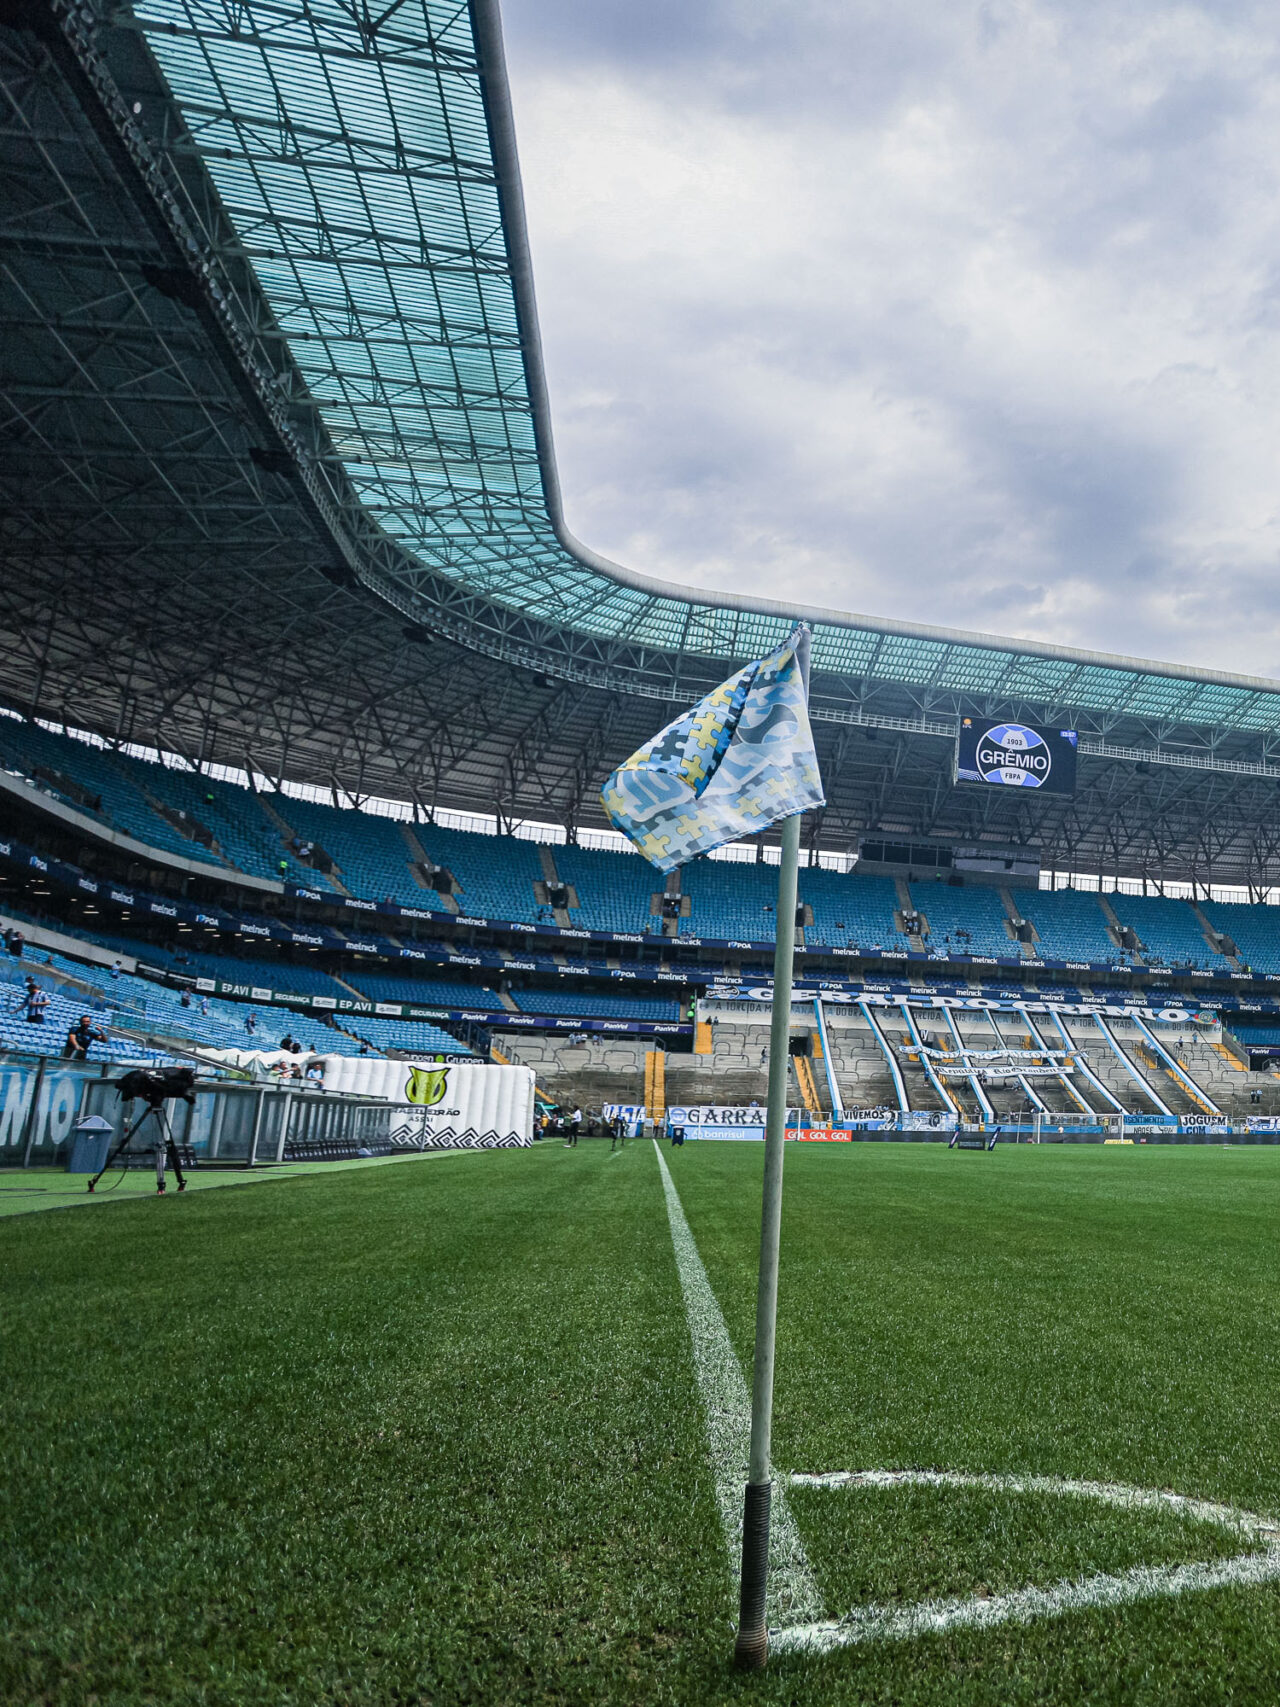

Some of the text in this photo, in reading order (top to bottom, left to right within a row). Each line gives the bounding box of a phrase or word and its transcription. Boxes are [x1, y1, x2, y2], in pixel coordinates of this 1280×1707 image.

[1007, 738, 1022, 746] 1903
[980, 748, 1047, 770] GRÊMIO
[111, 891, 133, 905] melnick
[305, 891, 321, 900] POA
[345, 900, 376, 910] melnick
[151, 904, 176, 917] melnick
[401, 908, 432, 920] melnick
[204, 917, 219, 926] POA
[456, 917, 487, 927] melnick
[241, 924, 270, 936] melnick
[521, 924, 536, 932] POA
[560, 929, 591, 938] melnick
[613, 934, 643, 942] melnick
[292, 934, 323, 945] melnick
[346, 942, 377, 952] melnick
[410, 951, 425, 959] POA
[450, 956, 480, 965] melnick
[504, 962, 535, 970] melnick
[558, 966, 589, 975] melnick
[410, 1009, 449, 1019] SEGURANÇA
[0, 1072, 76, 1146] MIO
[390, 1108, 460, 1116] RASILEIRÃO
[688, 1109, 765, 1125] GARRA
[844, 1111, 885, 1120] VIVEMOS
[1183, 1116, 1226, 1126] JOGUEM
[704, 1130, 745, 1138] banrisul
[809, 1131, 828, 1140] GOL
[831, 1132, 849, 1141] GOL
